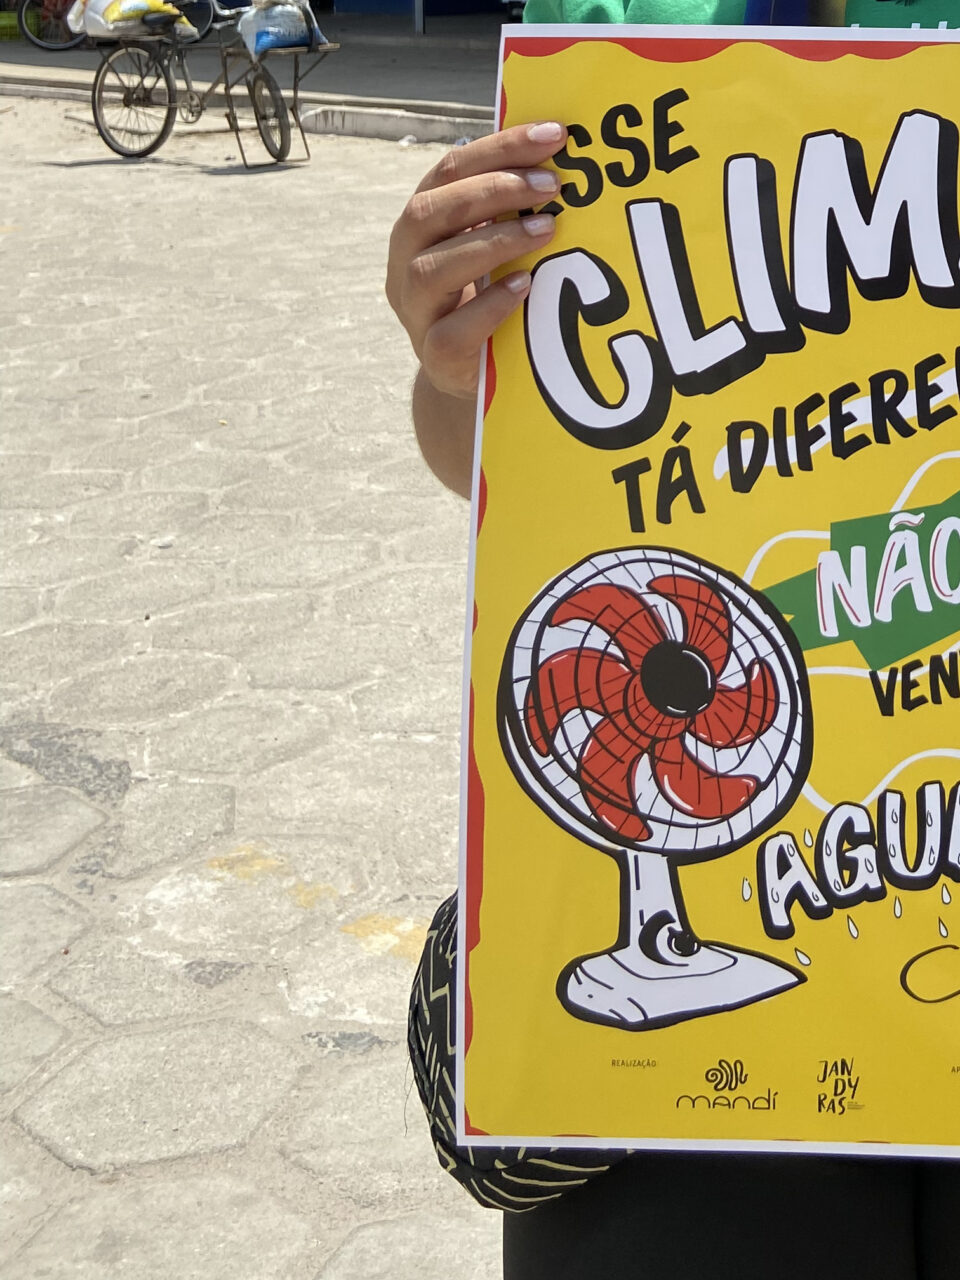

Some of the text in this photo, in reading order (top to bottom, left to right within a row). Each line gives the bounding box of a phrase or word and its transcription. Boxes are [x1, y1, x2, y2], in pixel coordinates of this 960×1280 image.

[519, 88, 700, 218] SSE
[611, 422, 707, 533] TÁ
[611, 1058, 657, 1069] REALIZAÇÃO
